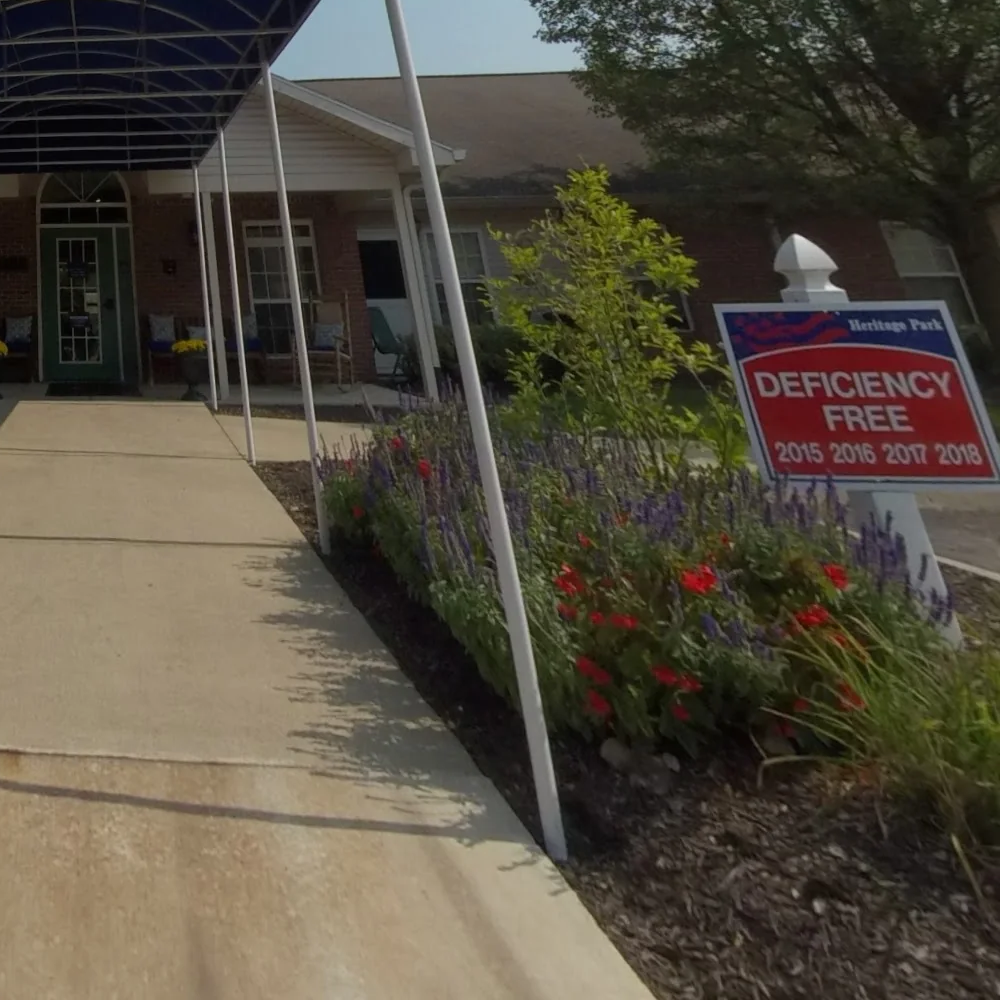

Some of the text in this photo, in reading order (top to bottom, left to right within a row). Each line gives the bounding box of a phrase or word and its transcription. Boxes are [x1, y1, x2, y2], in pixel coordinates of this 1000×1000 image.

[849, 318, 944, 333] Heritage Park
[753, 371, 952, 398] DEFICIENCY
[822, 405, 914, 432] FREE
[775, 442, 982, 466] 2015 2016 2017 2018
